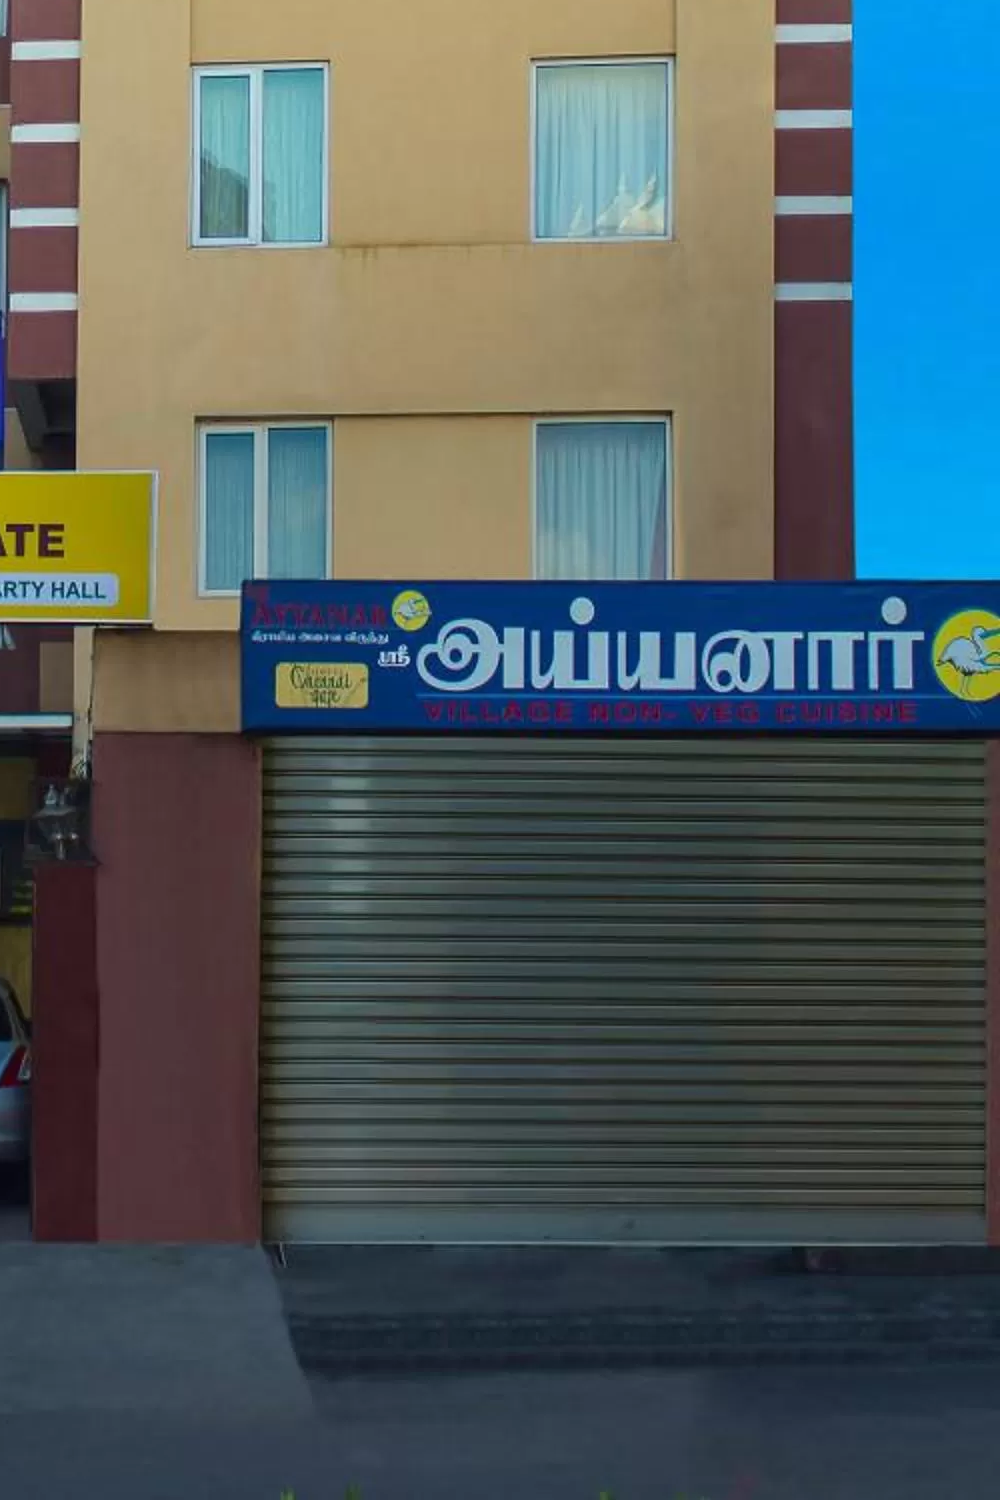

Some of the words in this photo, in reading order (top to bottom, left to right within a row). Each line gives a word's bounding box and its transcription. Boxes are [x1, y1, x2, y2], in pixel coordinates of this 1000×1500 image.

[50, 581, 107, 599] HALL
[416, 596, 925, 693] அய்யனார்
[423, 701, 576, 723] VILLAGE
[692, 701, 760, 723] VEG
[775, 701, 919, 724] CUISINE
